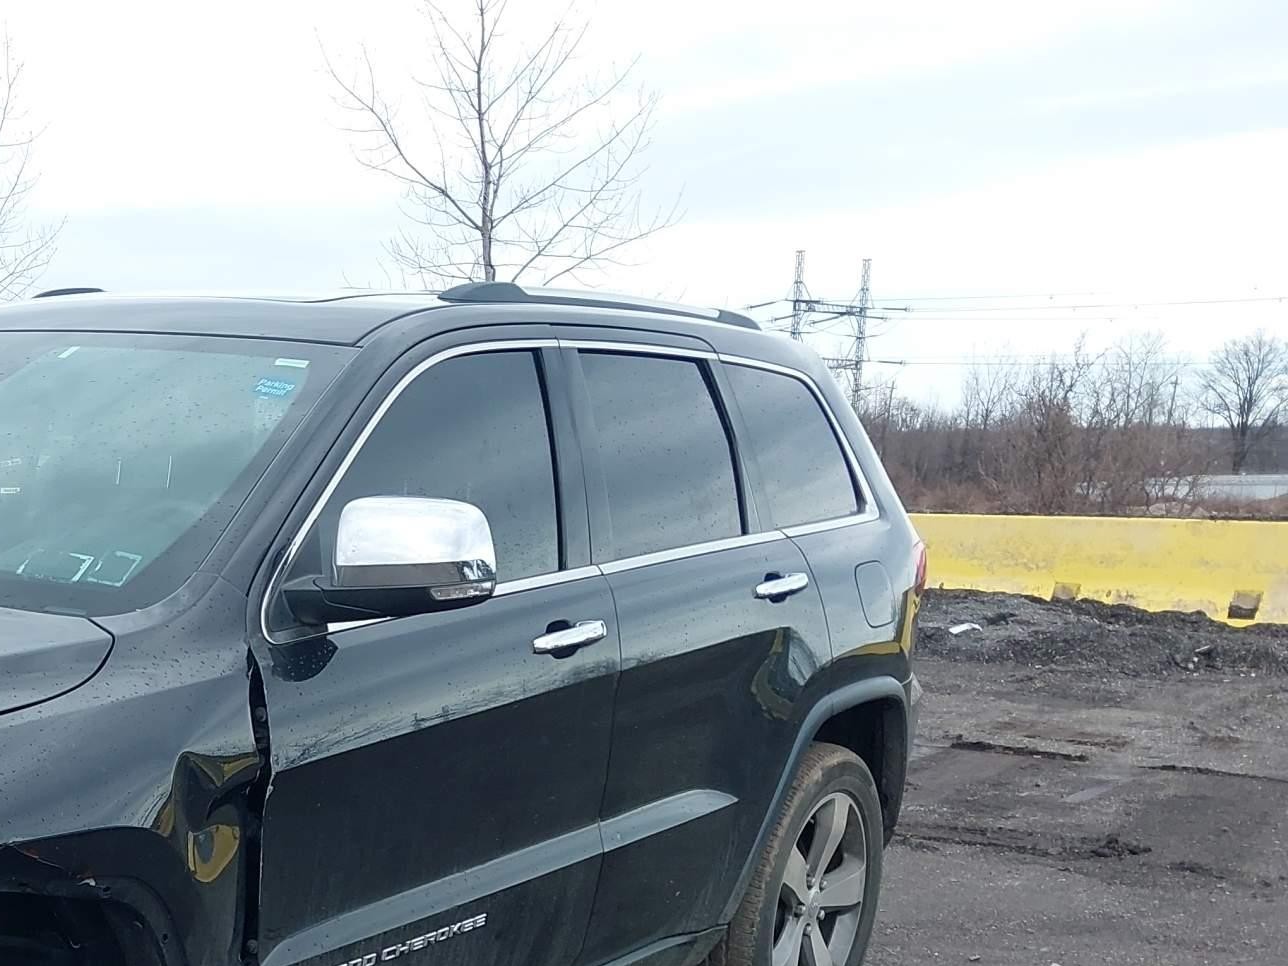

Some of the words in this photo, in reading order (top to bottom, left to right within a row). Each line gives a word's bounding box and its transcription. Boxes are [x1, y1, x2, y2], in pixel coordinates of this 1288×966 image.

[255, 385, 289, 396] Permit
[257, 378, 295, 391] Parking
[380, 912, 488, 962] CHEROKEE
